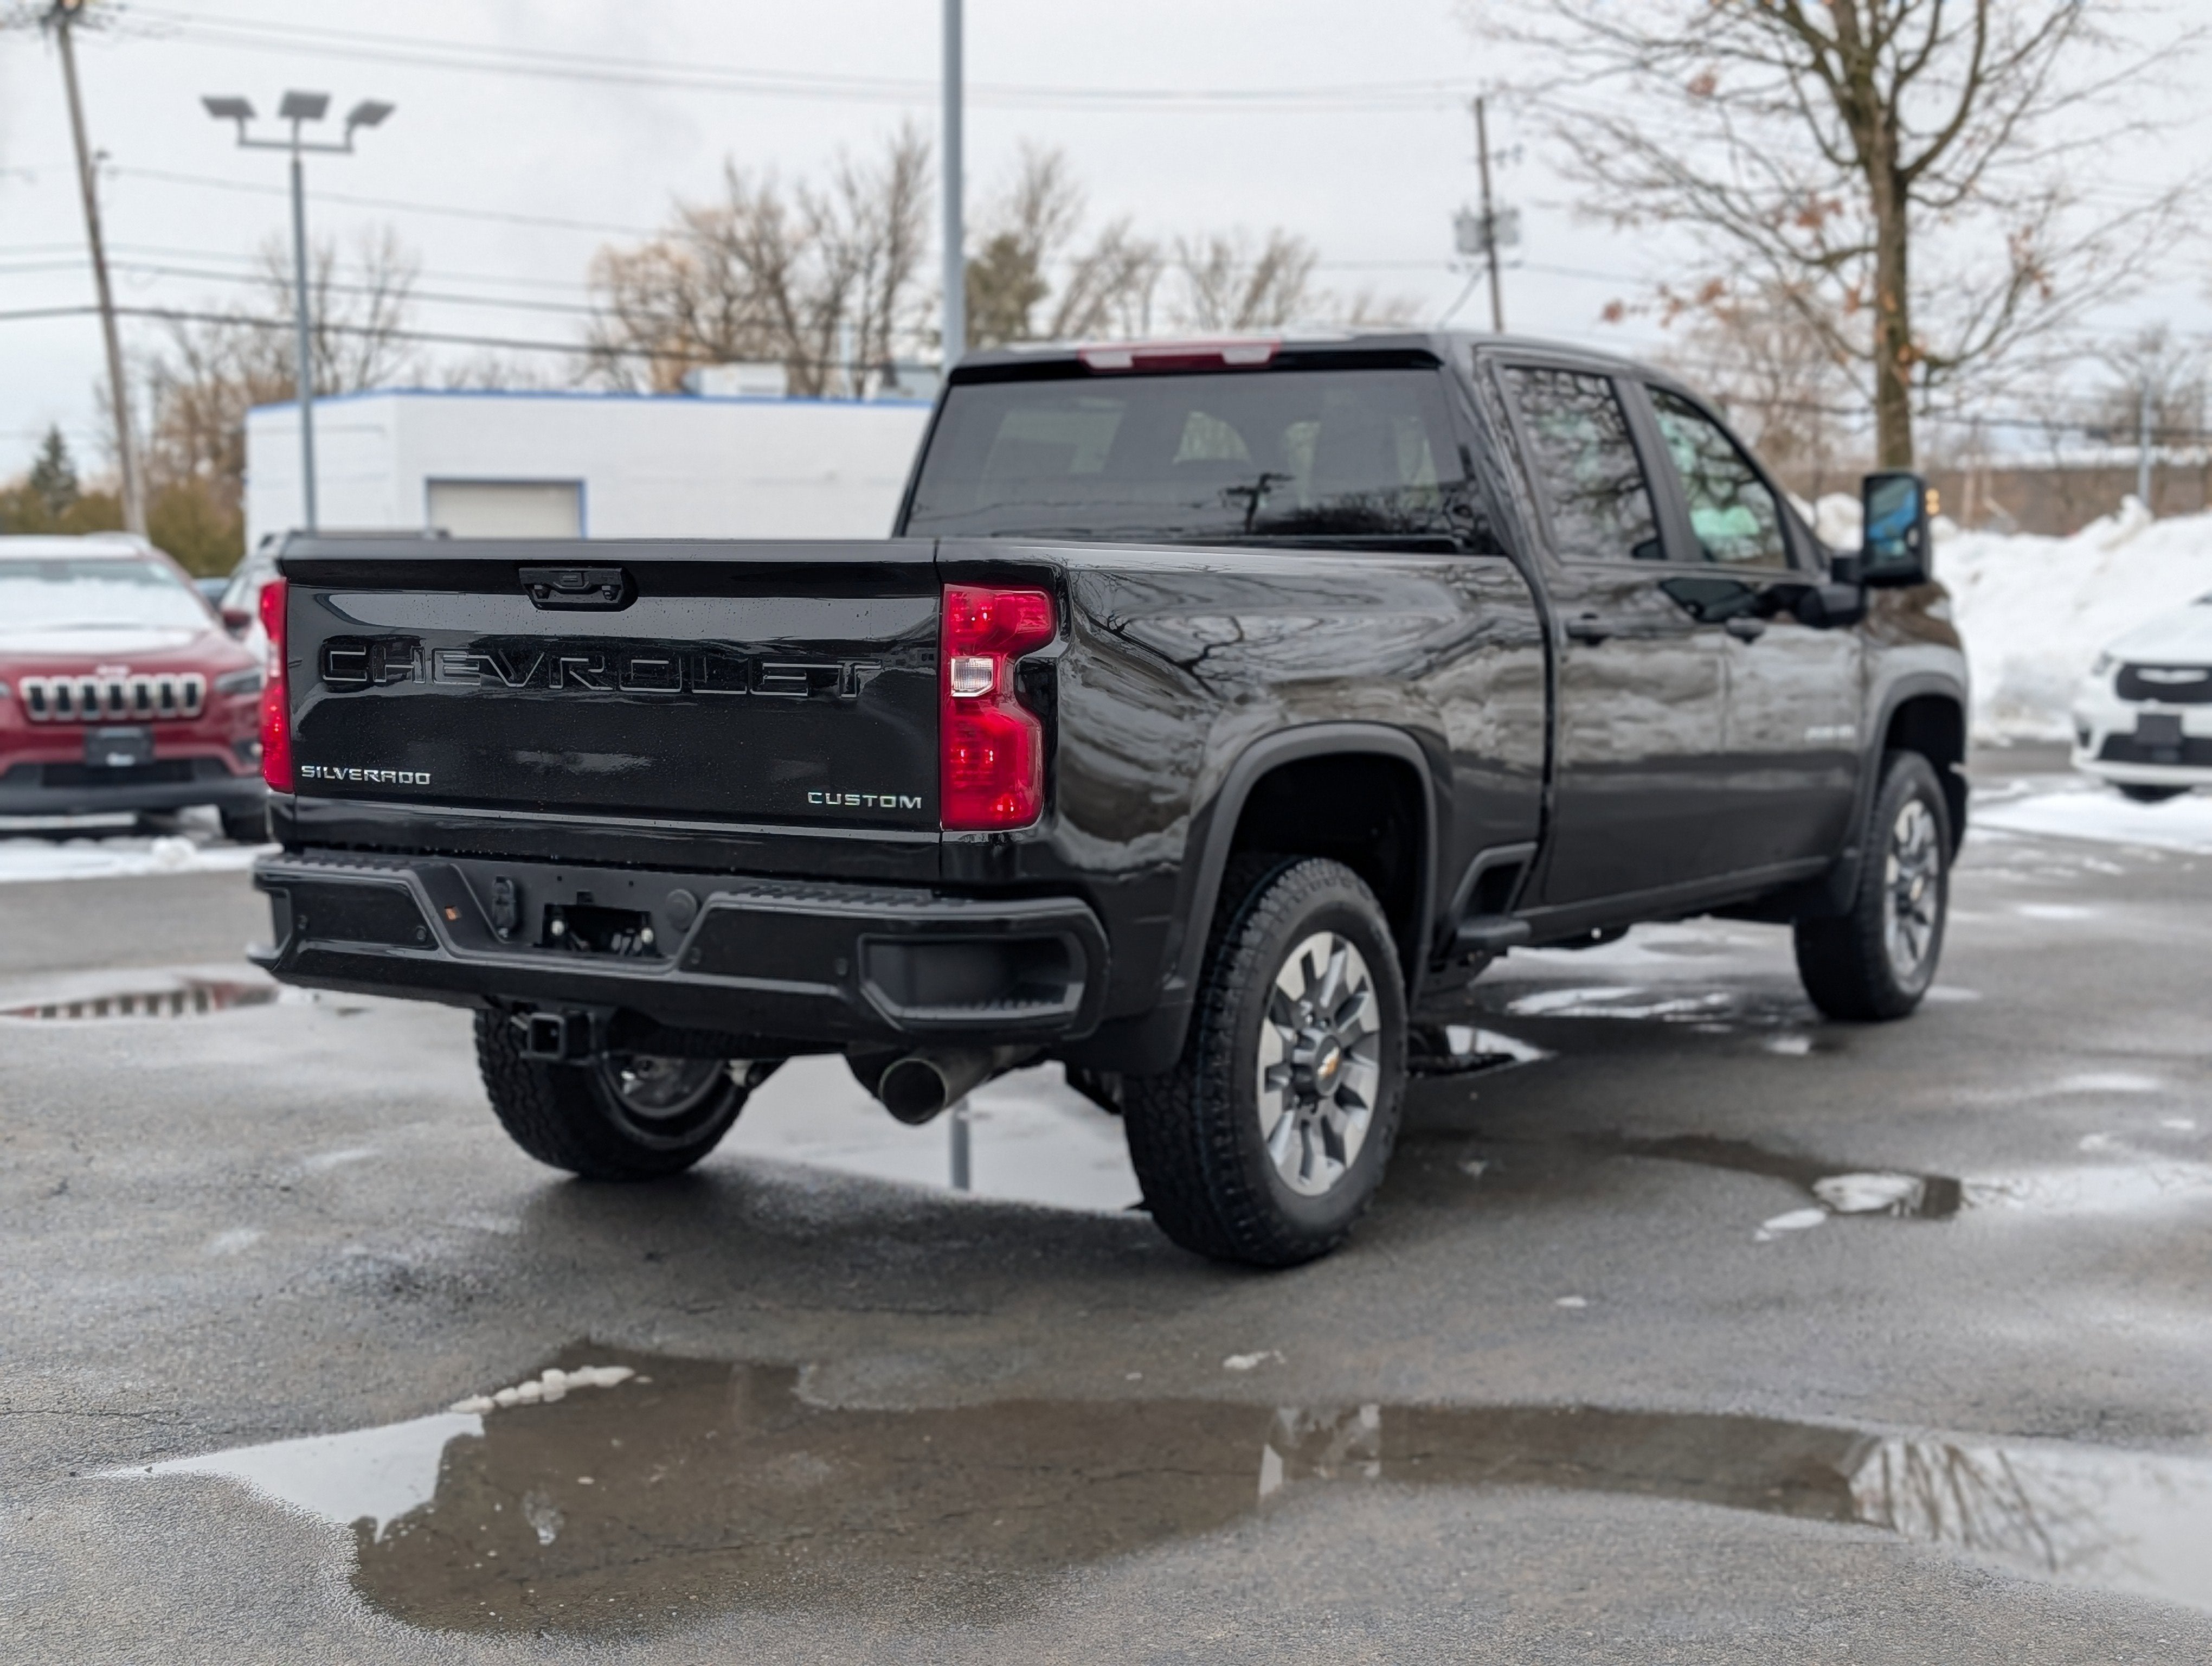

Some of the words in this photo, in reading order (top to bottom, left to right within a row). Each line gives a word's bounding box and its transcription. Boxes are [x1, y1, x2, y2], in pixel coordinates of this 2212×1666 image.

[321, 644, 883, 699] CHEVROLET
[301, 765, 432, 785] SILVERADO
[808, 792, 922, 809] CUSTOM
